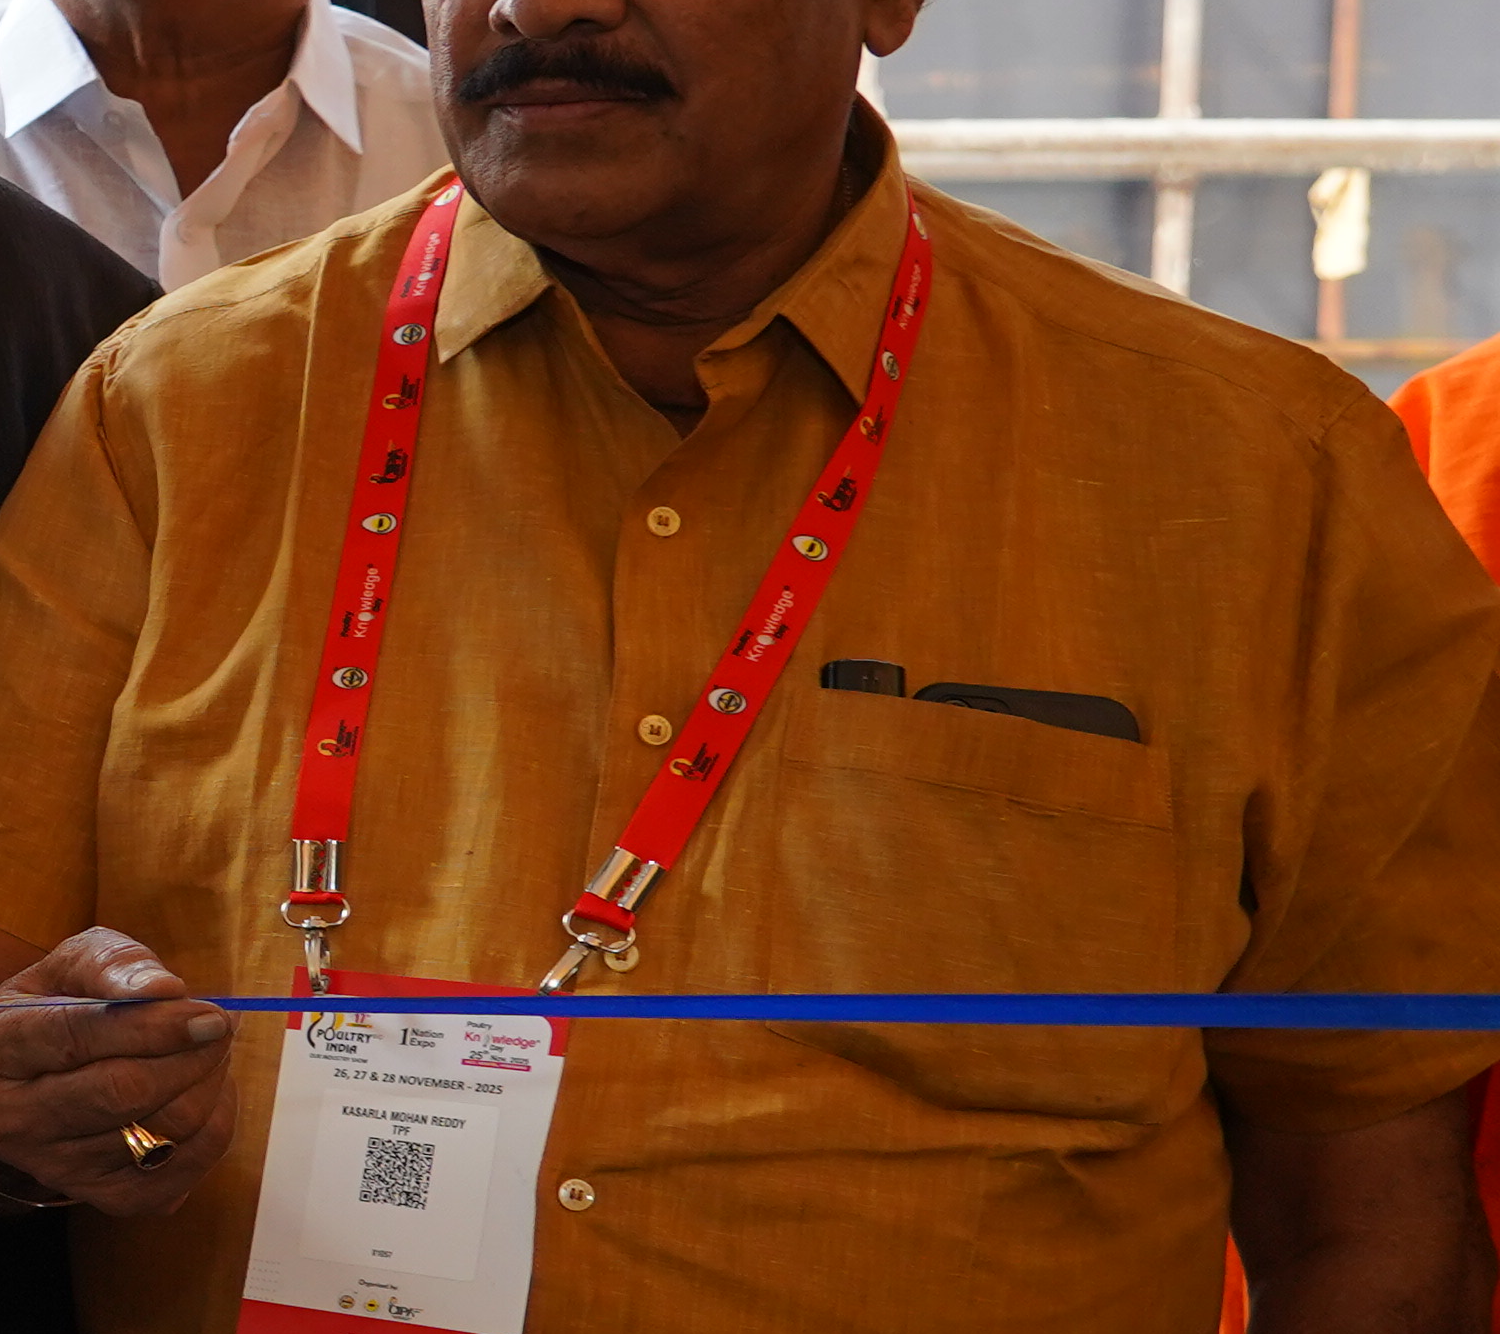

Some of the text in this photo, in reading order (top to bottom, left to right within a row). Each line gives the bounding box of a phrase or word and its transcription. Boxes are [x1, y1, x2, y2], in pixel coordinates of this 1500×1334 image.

[411, 1028, 444, 1038] Nation
[409, 1037, 436, 1048] Expo
[326, 1043, 357, 1054] INDIA
[334, 1068, 350, 1080] 26,
[353, 1070, 367, 1079] 27
[369, 1073, 378, 1081] &
[382, 1073, 396, 1083] 28
[399, 1075, 465, 1091] NOVEMBER
[475, 1083, 503, 1094] 2025
[390, 1110, 428, 1125] MOHAN
[430, 1116, 466, 1130] REDDY
[392, 1125, 411, 1136] TPF
